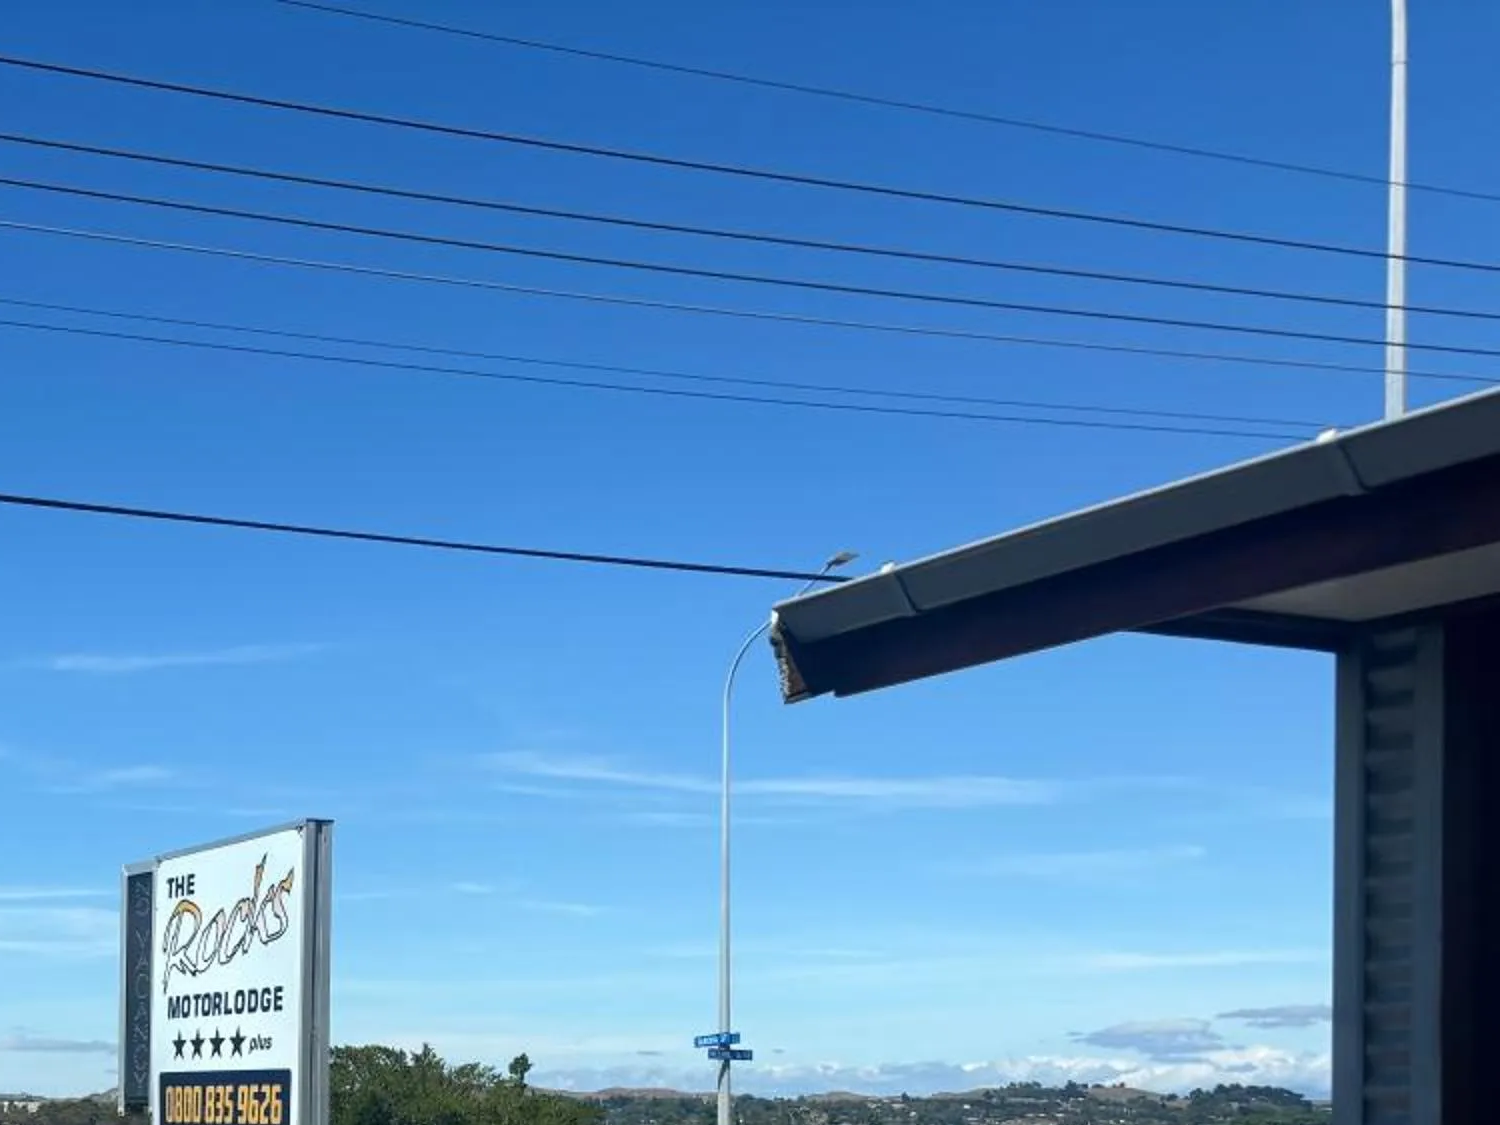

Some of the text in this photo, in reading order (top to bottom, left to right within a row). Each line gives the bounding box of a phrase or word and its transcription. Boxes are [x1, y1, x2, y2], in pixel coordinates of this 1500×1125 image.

[167, 874, 195, 898] THE
[163, 852, 295, 995] Rocks
[167, 986, 284, 1020] MOTORLODGE
[248, 1034, 273, 1055] plus
[165, 1083, 282, 1125] 0800 835 9626
